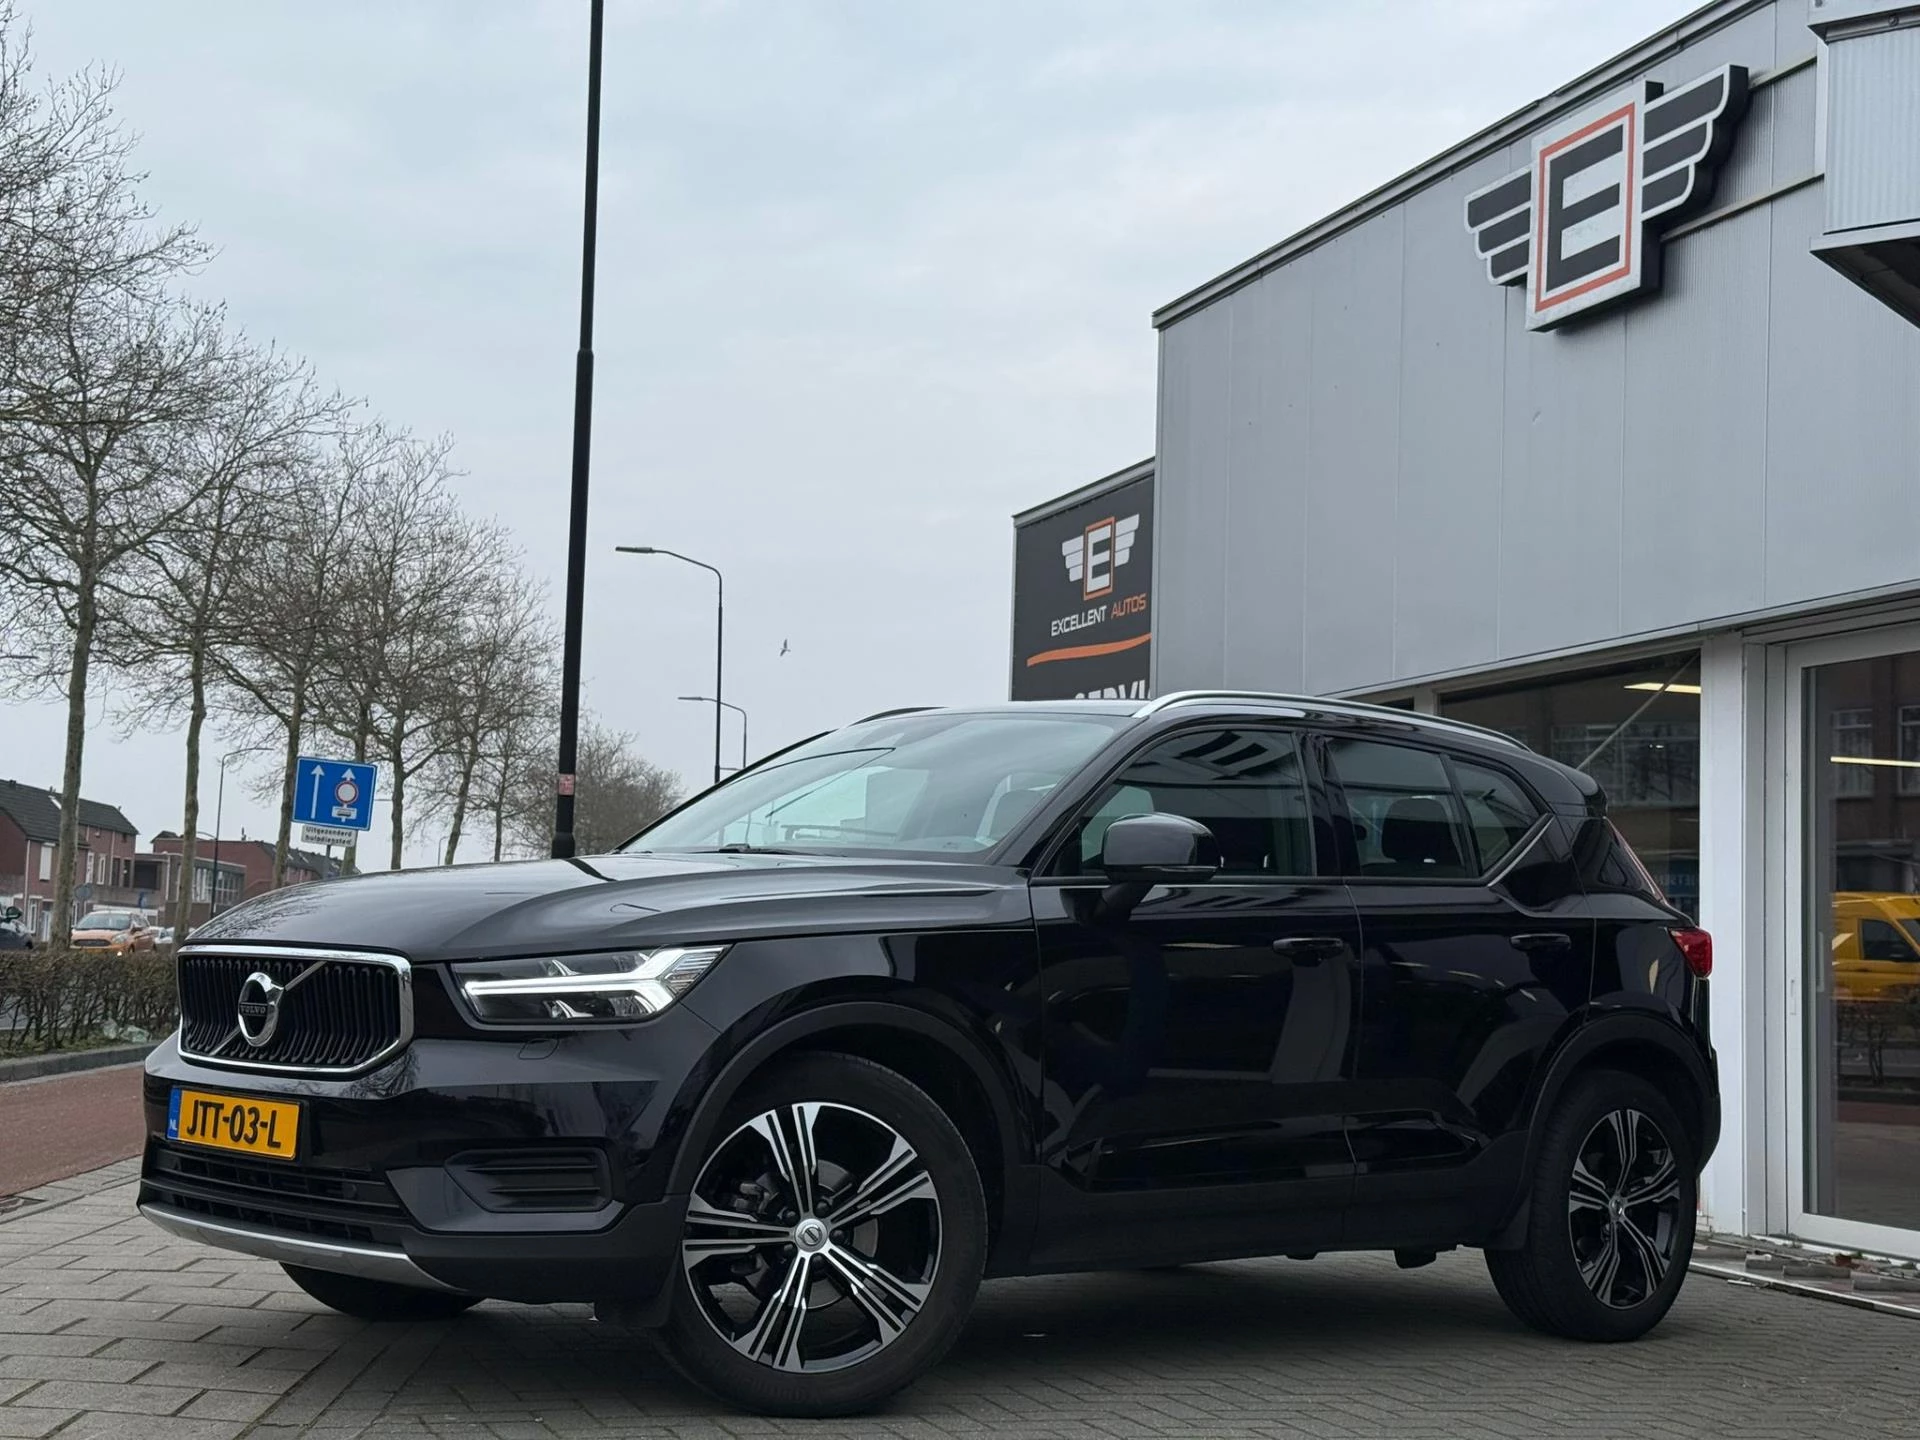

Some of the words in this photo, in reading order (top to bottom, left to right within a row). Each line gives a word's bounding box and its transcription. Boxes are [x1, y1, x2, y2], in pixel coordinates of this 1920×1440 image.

[1051, 605, 1107, 637] EXCELLENT
[1111, 593, 1147, 620] AUTOS
[169, 1118, 178, 1131] NL
[186, 1099, 282, 1149] JTT-03-L
